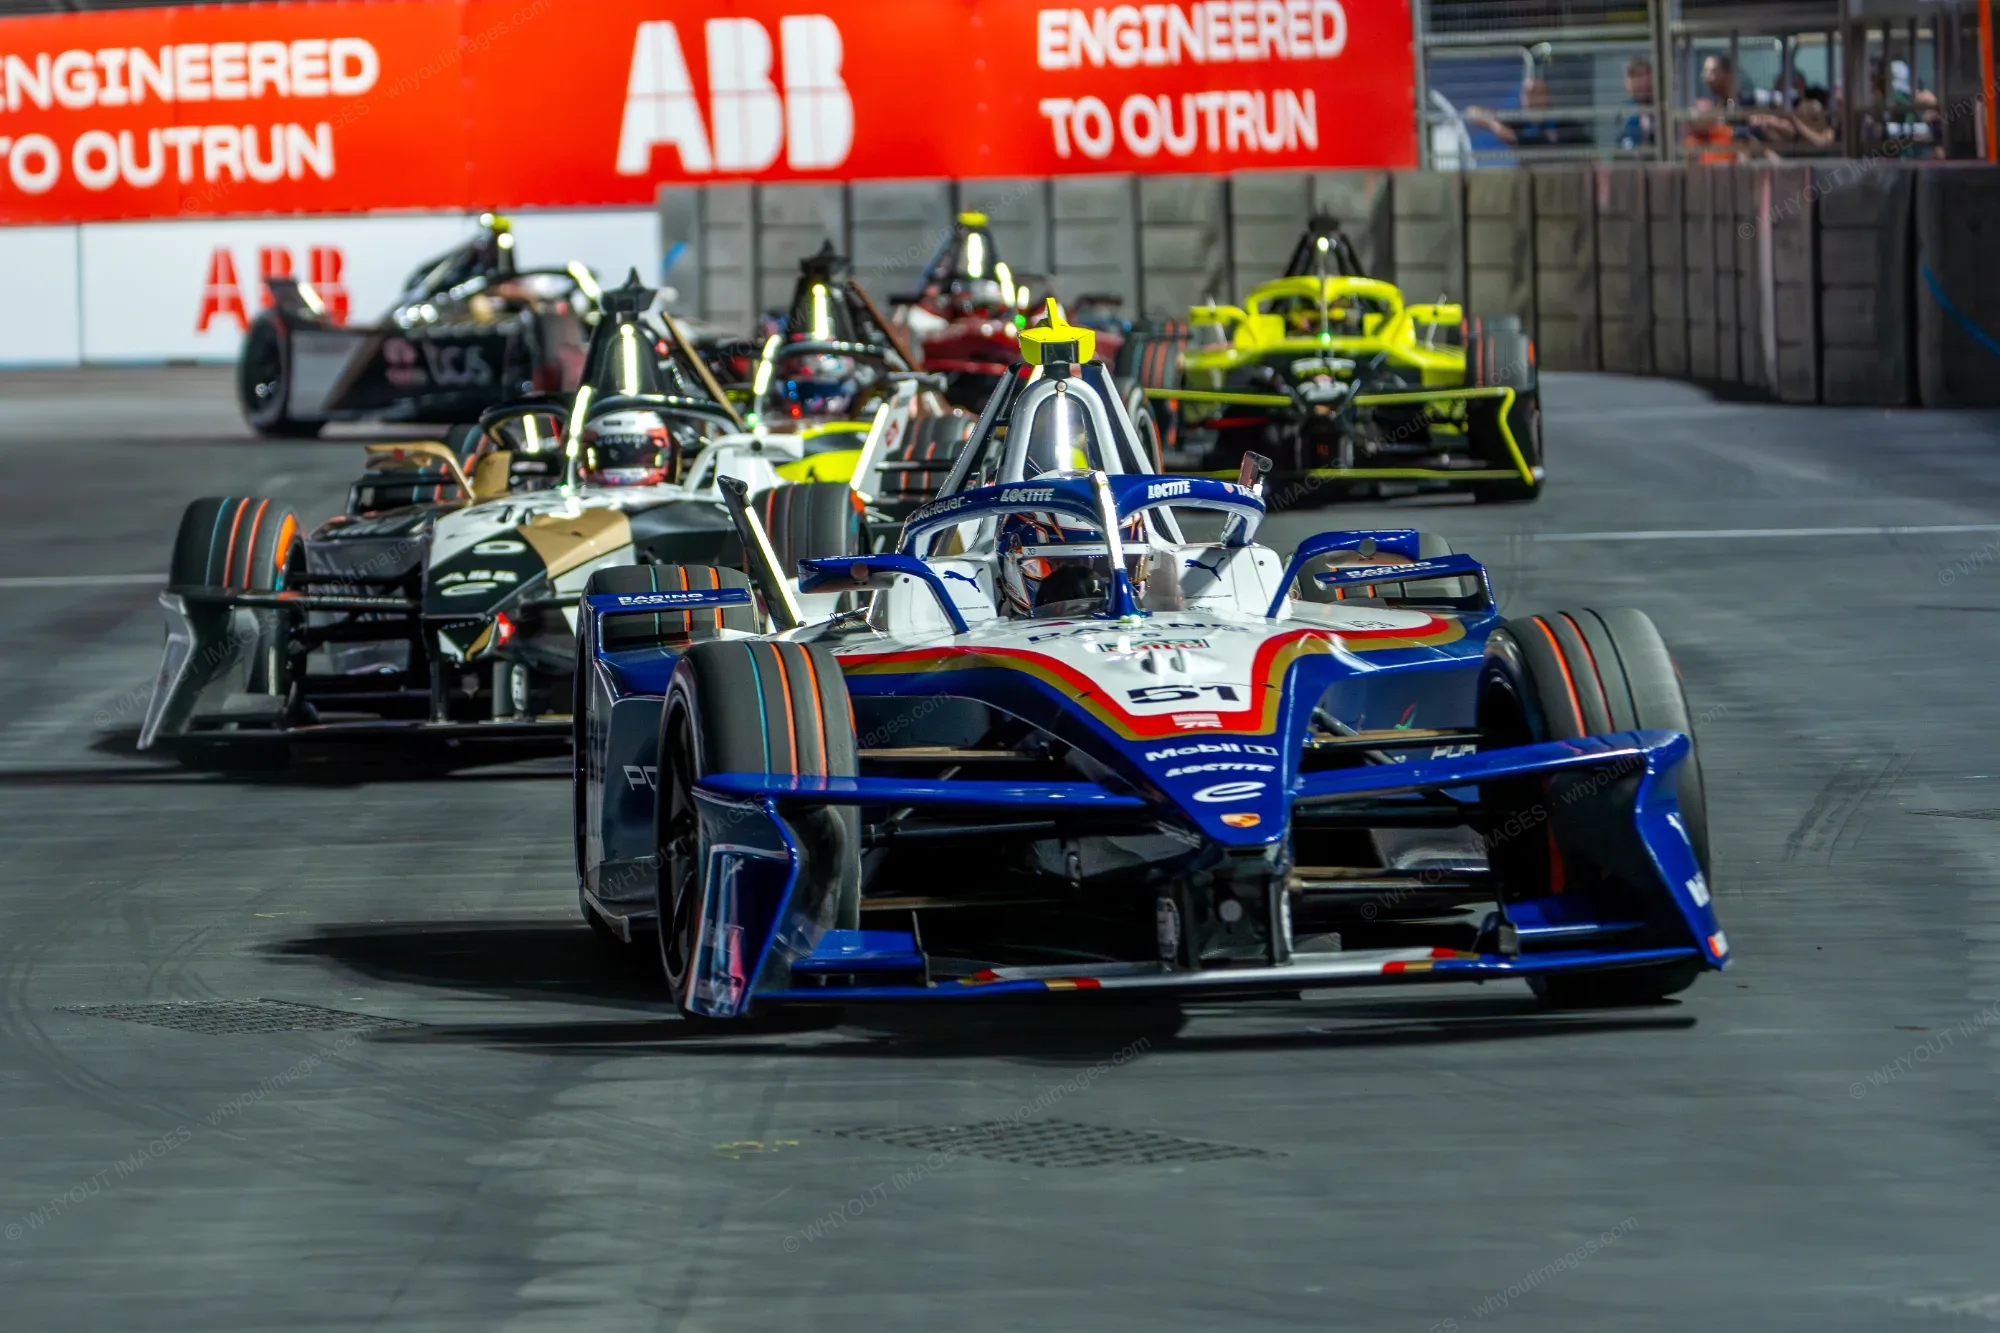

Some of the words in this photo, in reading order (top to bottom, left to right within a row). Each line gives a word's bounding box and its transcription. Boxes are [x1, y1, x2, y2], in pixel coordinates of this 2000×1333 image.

[1037, 0, 1347, 70] ENGINEERED
[0, 37, 380, 112] NGINEERED
[616, 14, 854, 174] ABB
[72, 122, 335, 189] OUTRUN
[1040, 96, 1114, 158] TO
[1121, 89, 1318, 156] OUTRUN
[1000, 488, 1055, 503] LOCTITE
[1147, 480, 1191, 499] LOCTITE
[1126, 684, 1241, 704] 51
[1144, 743, 1241, 762] Mobil
